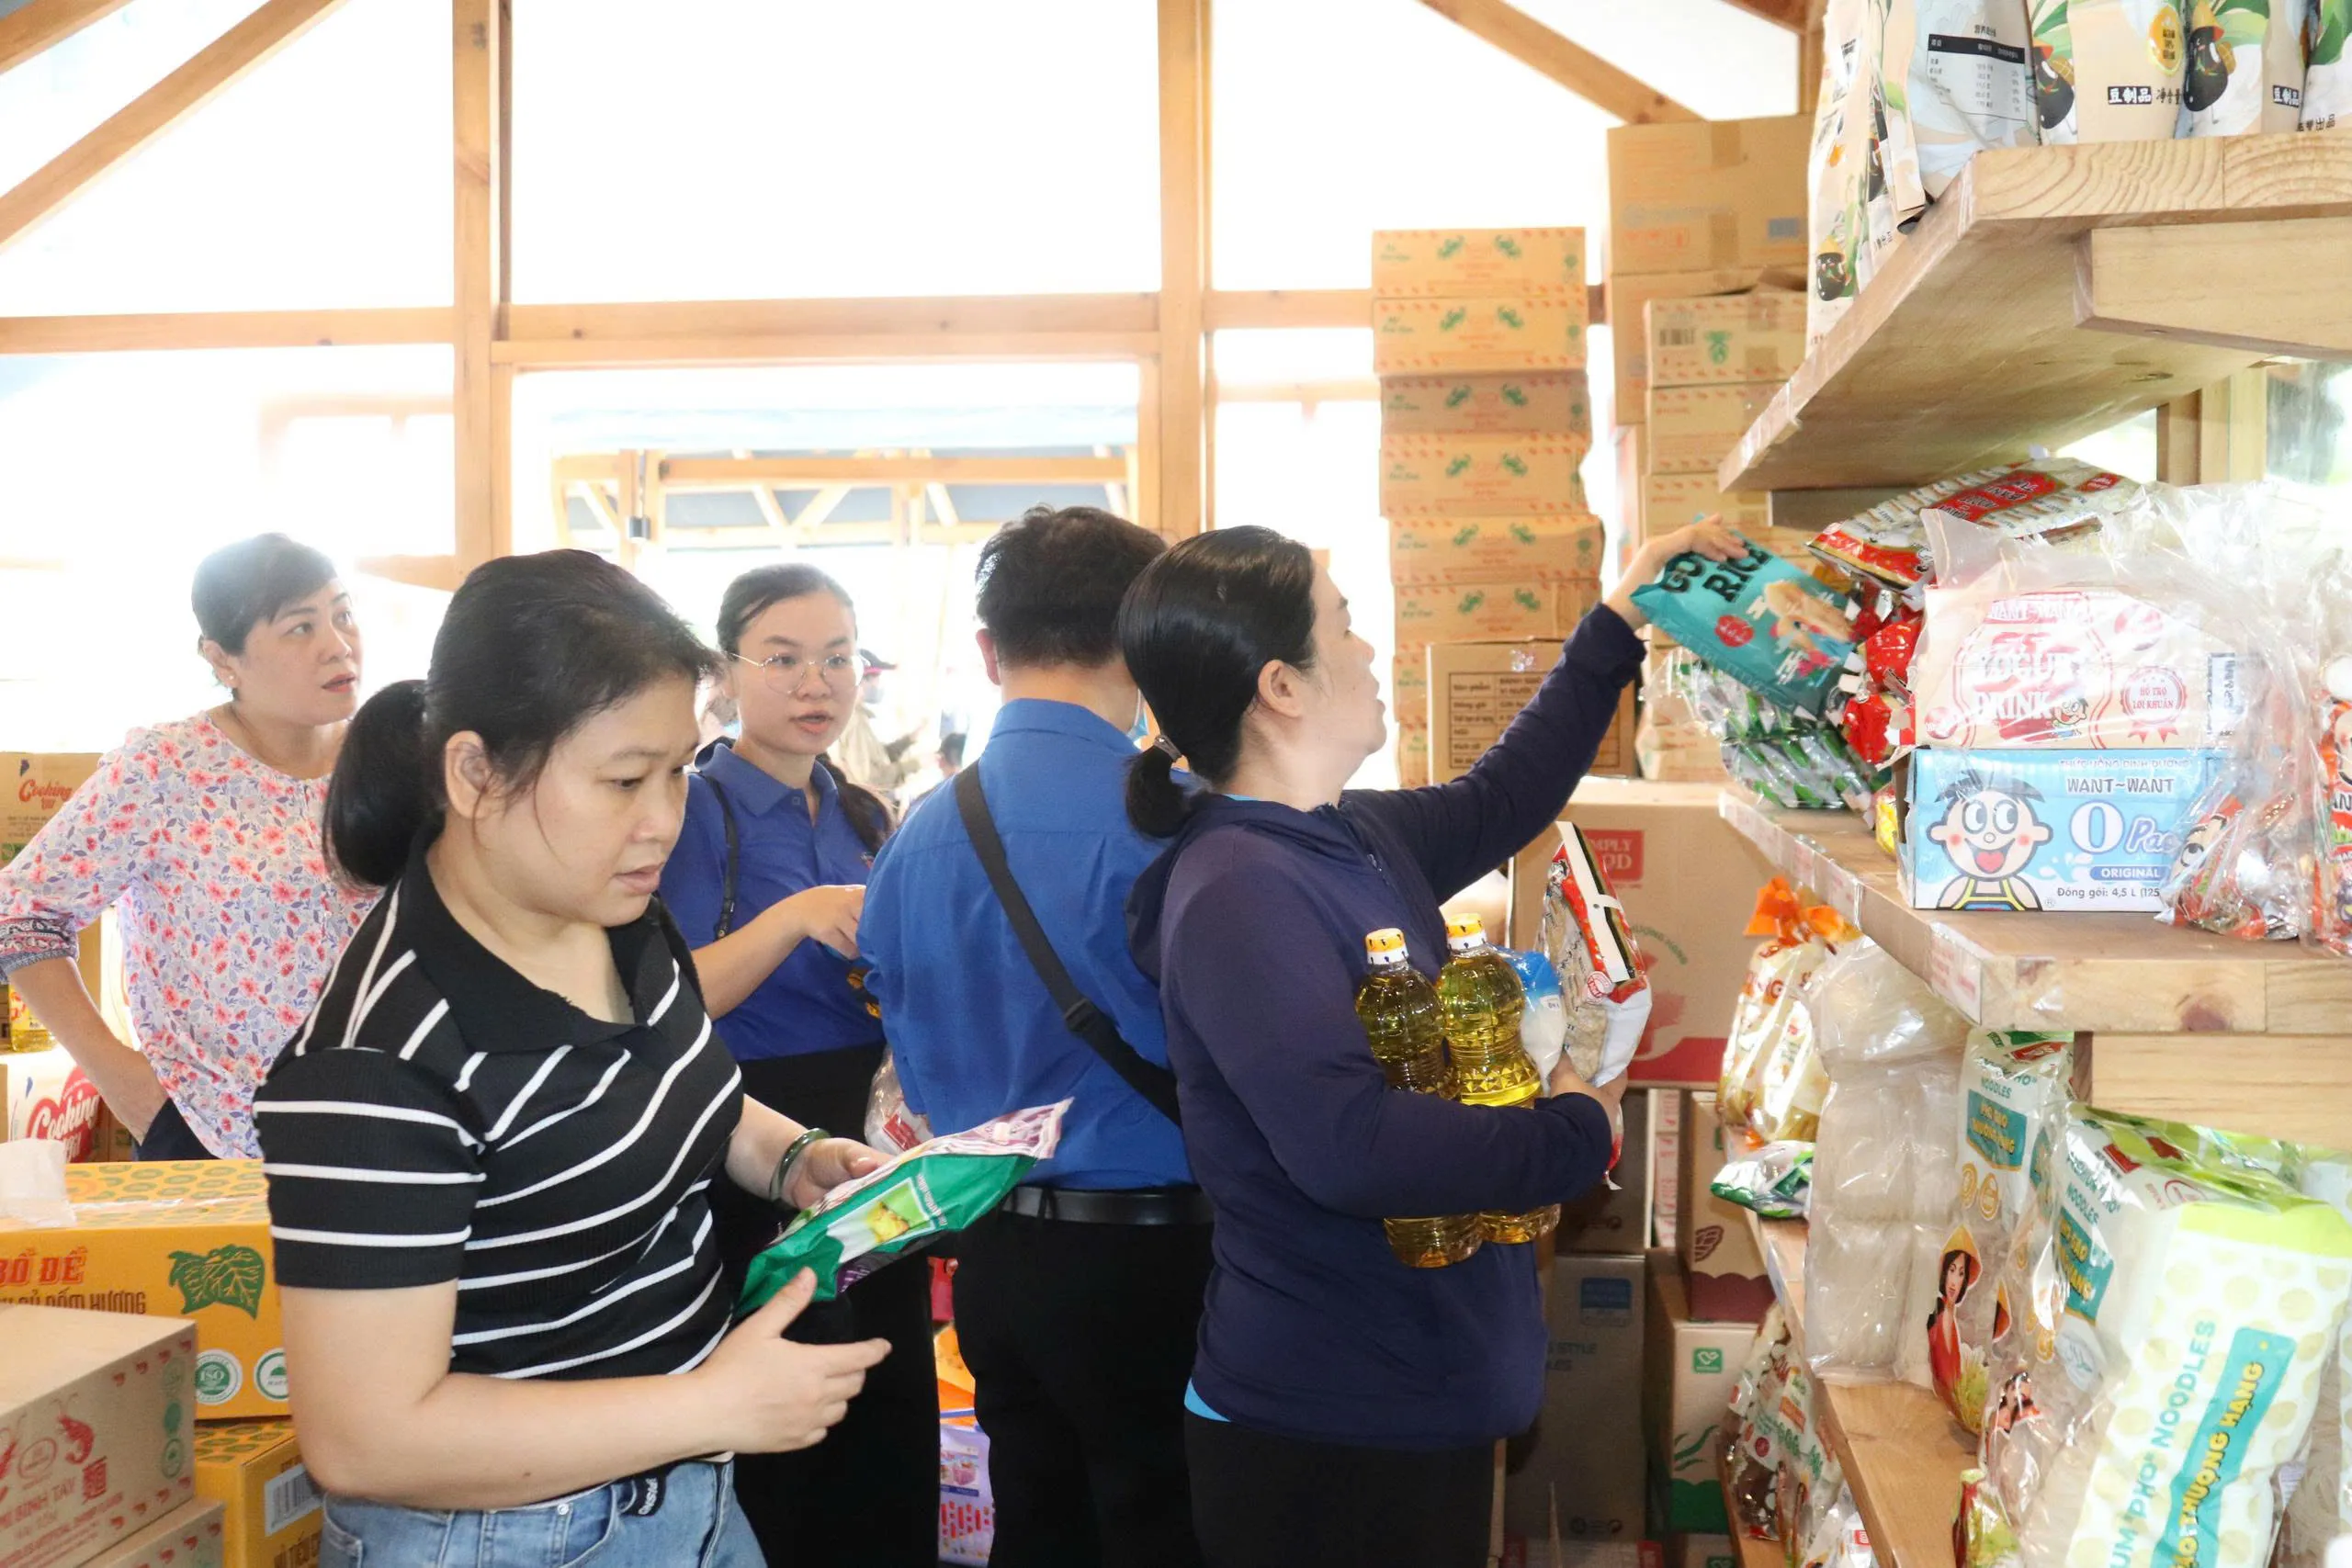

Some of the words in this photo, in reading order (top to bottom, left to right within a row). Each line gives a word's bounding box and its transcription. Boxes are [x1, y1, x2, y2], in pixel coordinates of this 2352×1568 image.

[1702, 547, 1771, 603] RICE
[2101, 867, 2159, 878] ORIGINAL
[2057, 887, 2086, 898] Đóng
[2111, 887, 2128, 898] 4,5
[32, 1089, 101, 1139] Cooking
[200, 1369, 224, 1382] ISO
[2151, 1320, 2216, 1450] NOODLES
